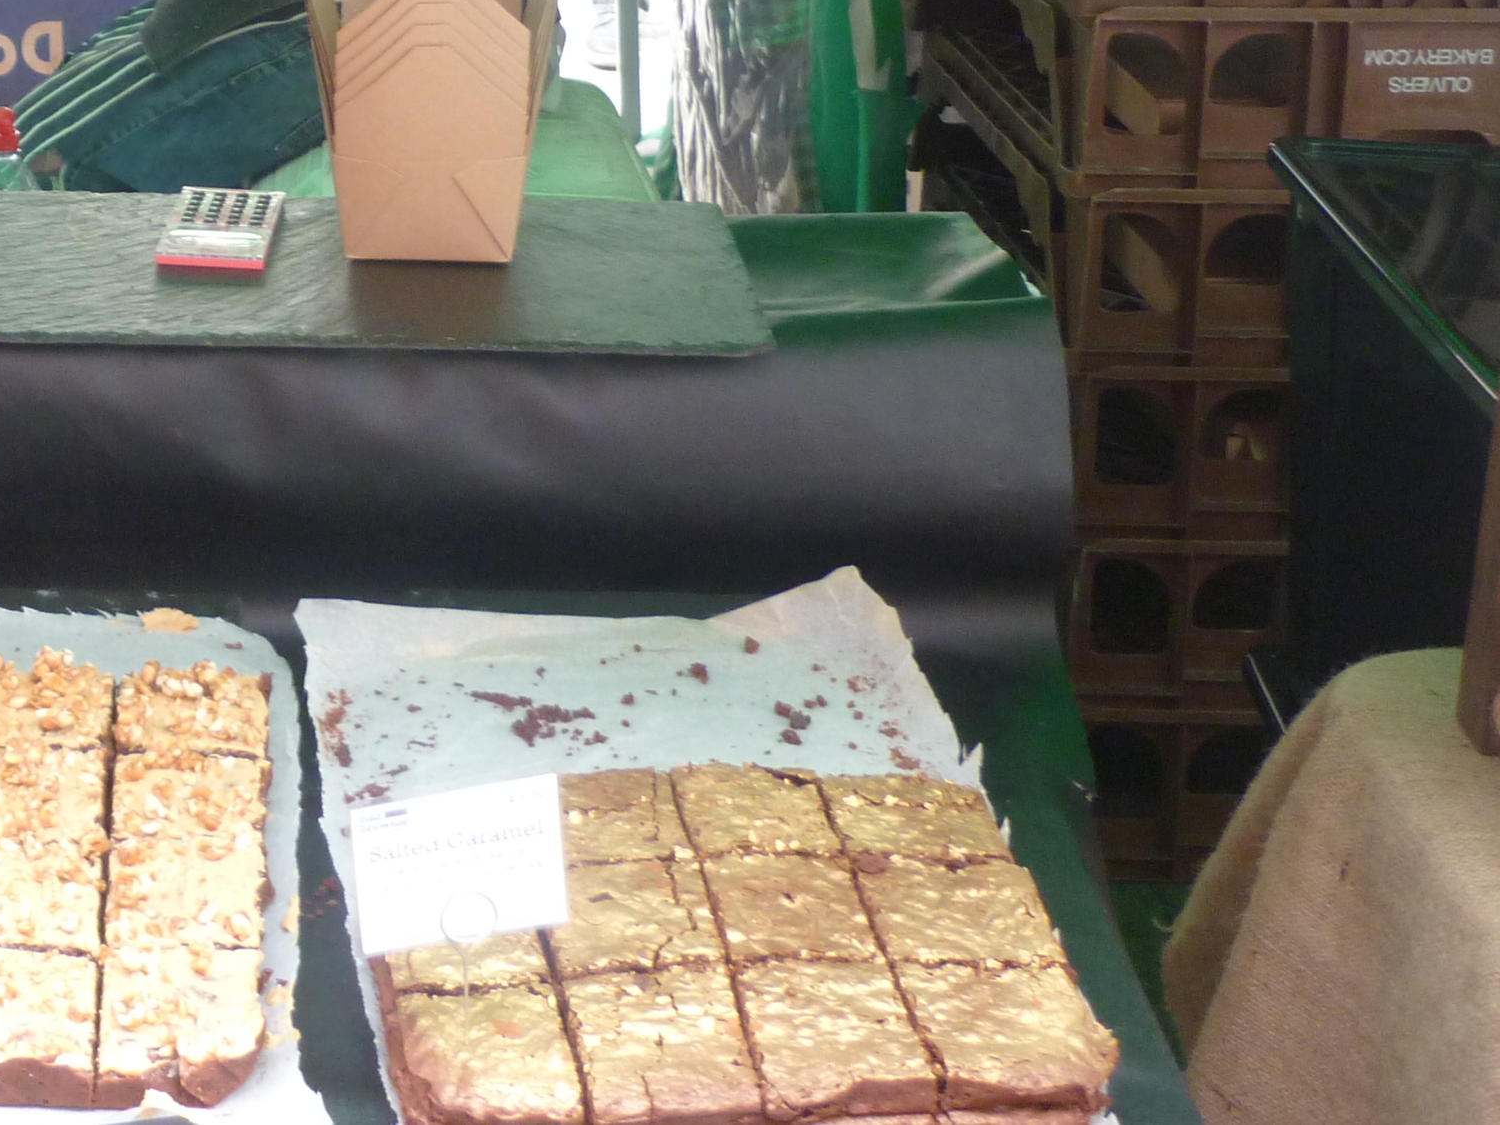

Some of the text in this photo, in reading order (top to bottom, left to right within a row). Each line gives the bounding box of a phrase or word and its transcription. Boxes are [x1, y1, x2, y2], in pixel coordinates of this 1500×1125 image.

[1363, 48, 1495, 66] BAKERY.COM
[369, 819, 545, 864] Salted Caramel
